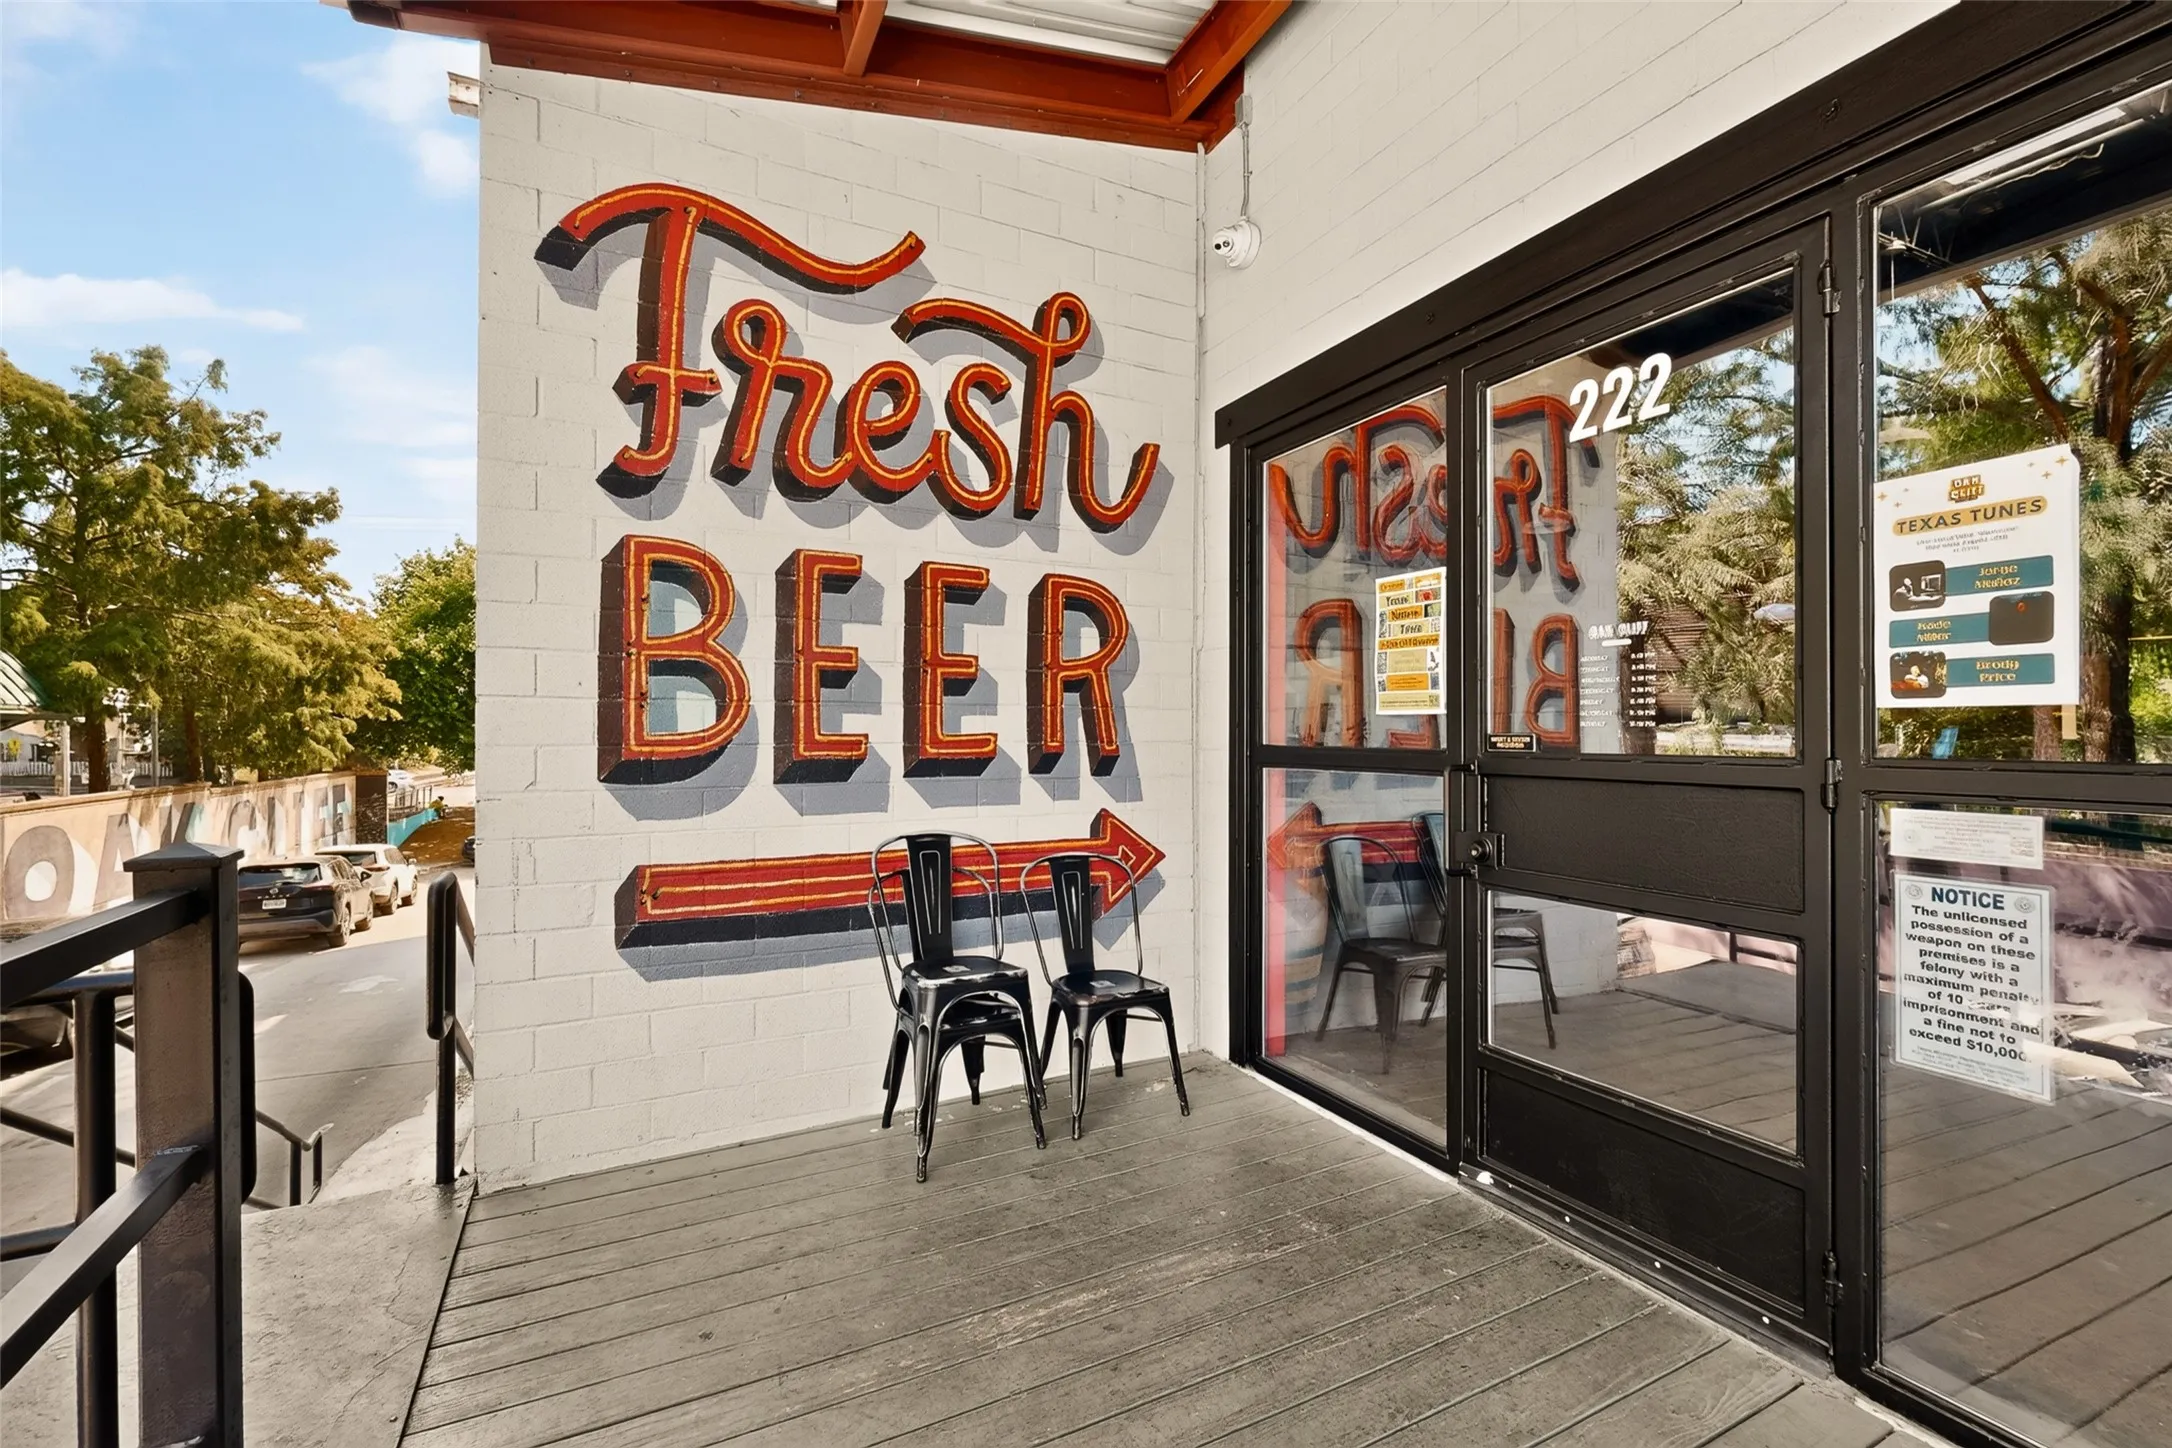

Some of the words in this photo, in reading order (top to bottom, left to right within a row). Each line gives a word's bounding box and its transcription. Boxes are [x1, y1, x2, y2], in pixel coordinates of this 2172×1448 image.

[534, 182, 1161, 534] Fresh
[1569, 352, 1672, 443] 222
[1897, 512, 1961, 534] TEXAS
[1970, 499, 2042, 522] TUNES
[598, 534, 1128, 785] BEER
[1931, 886, 2005, 910] NOTICE
[1912, 904, 1939, 918] The
[1943, 909, 2028, 930] unlicensed
[1910, 919, 1993, 940] possession
[1998, 931, 2014, 943] of
[2019, 935, 2029, 945] a
[1905, 932, 1962, 949] weapon
[1967, 942, 1986, 952] on
[1991, 943, 2036, 961] these
[1919, 948, 1986, 967] premises
[1992, 958, 2006, 970] is
[2010, 963, 2020, 973] a
[1920, 960, 1965, 979] felony
[1970, 970, 2003, 984] with
[2008, 977, 2019, 987] a
[1904, 972, 1975, 993] maximum
[1927, 990, 1942, 1000] of
[1947, 992, 1964, 1005] 10
[1903, 997, 2005, 1028] imprisonment
[2010, 1020, 2040, 1036] and
[1908, 1027, 1962, 1047] exceed
[1923, 1017, 1932, 1027] a
[1937, 1018, 1965, 1034] fine
[1969, 1027, 1995, 1041] not
[1999, 1033, 2016, 1045] to
